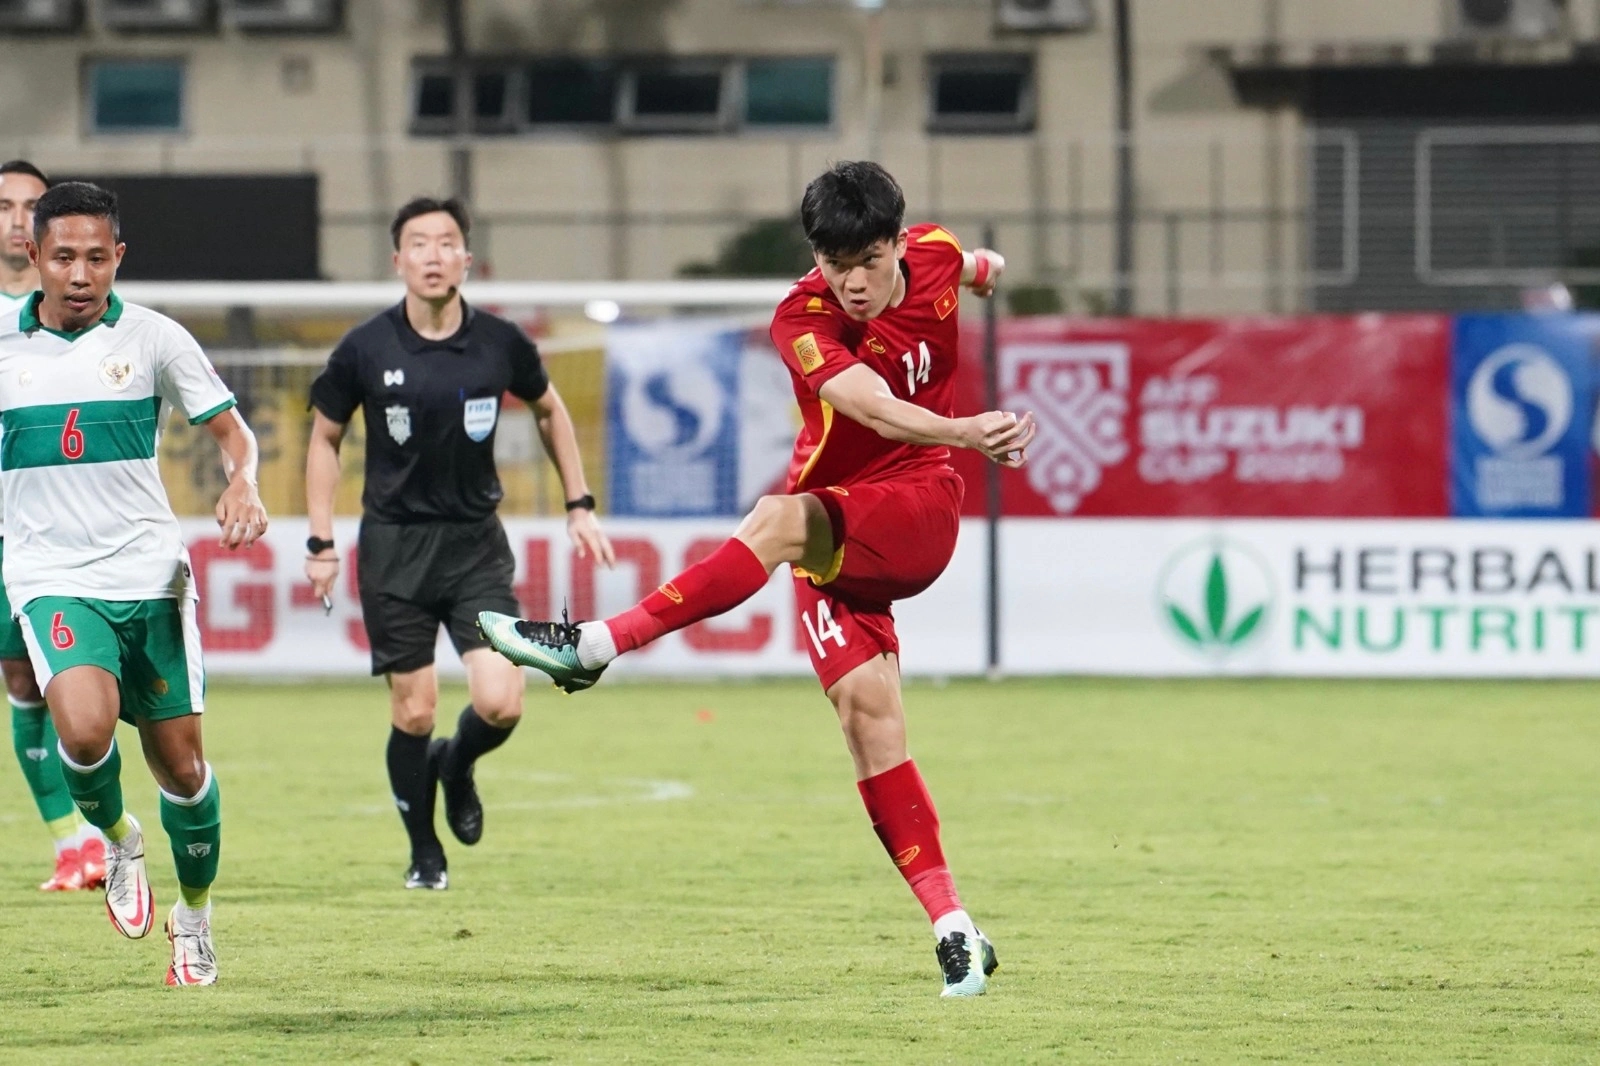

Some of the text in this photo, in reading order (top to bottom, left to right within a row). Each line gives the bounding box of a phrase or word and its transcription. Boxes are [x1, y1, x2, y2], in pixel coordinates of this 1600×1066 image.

[902, 341, 931, 396] 14
[468, 402, 492, 412] FIFA
[1140, 406, 1364, 449] SUZUKI
[61, 408, 85, 460] 6
[1138, 450, 1228, 483] CUP
[1295, 547, 1600, 593] HERBAL
[51, 612, 75, 649] 6
[802, 599, 846, 659] 14
[1294, 606, 1599, 653] NUTRIT
